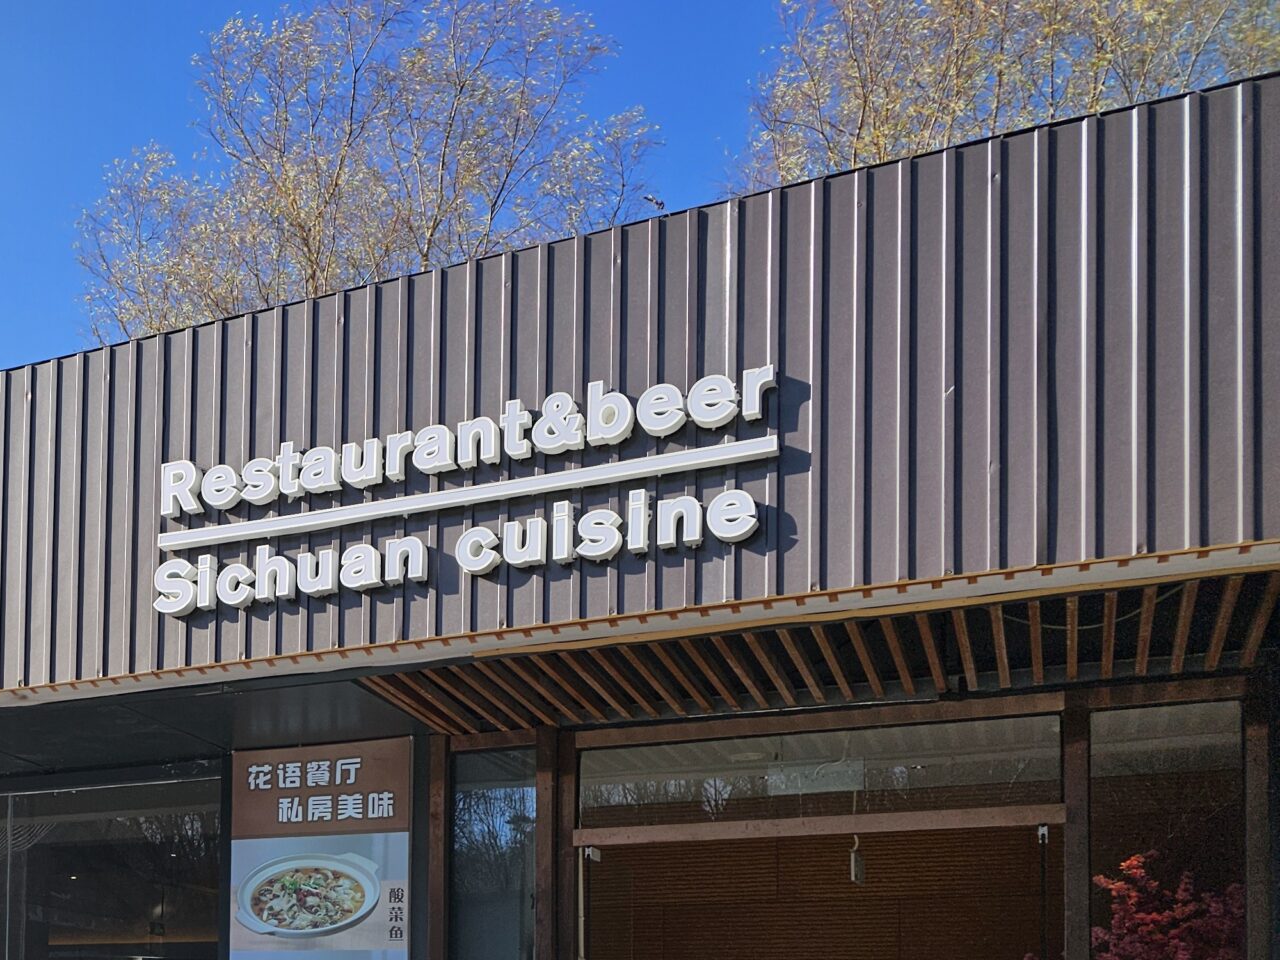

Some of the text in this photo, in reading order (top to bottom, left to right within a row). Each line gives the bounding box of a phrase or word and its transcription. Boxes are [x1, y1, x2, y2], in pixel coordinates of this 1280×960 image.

[160, 364, 777, 518] Restaurant&beer
[153, 486, 759, 617] Sichuan cuisine
[248, 757, 362, 791] 花语餐厅
[278, 791, 395, 824] 私房美味
[388, 887, 405, 942] 酸菜鱼
